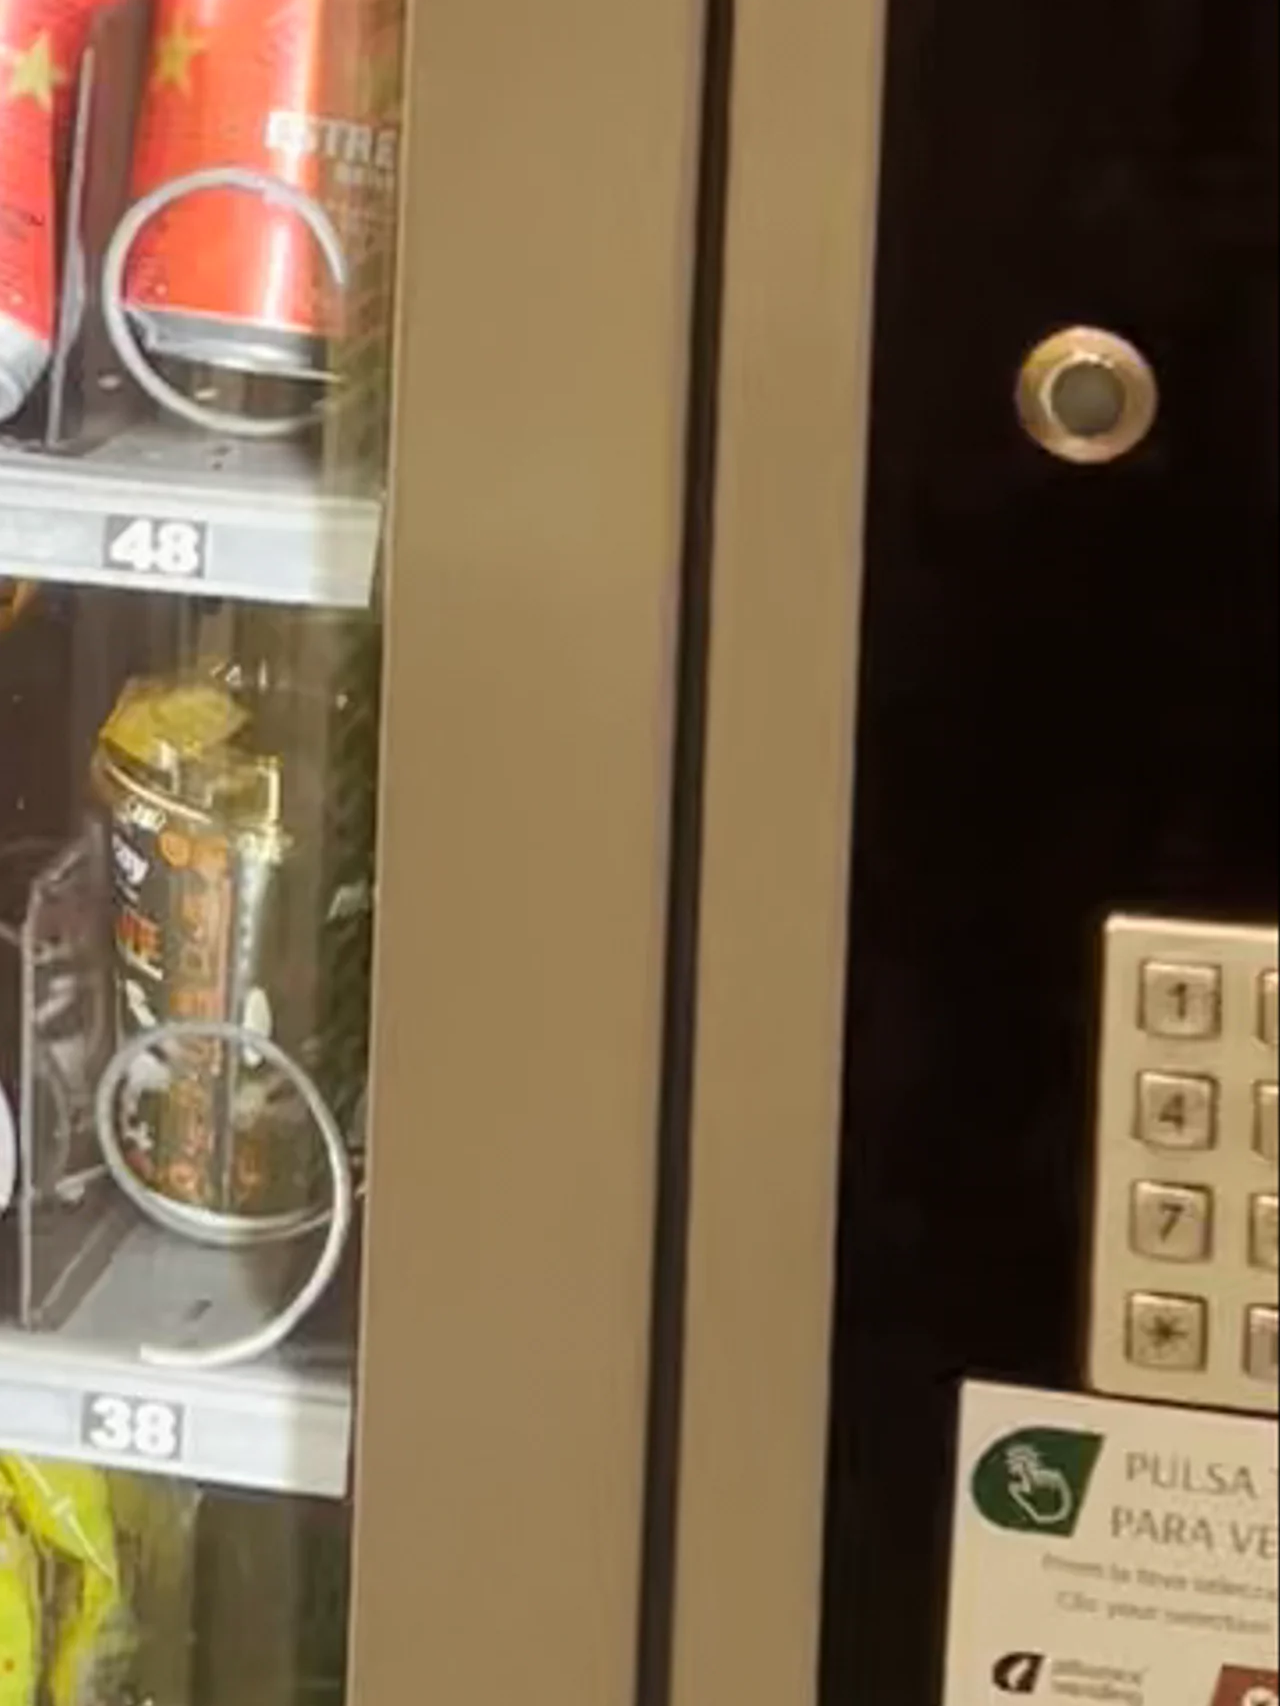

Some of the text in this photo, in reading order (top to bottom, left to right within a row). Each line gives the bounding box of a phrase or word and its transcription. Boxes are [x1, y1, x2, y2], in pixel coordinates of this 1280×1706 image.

[107, 518, 202, 573] 48
[1158, 1092, 1185, 1135] 4
[1158, 1202, 1186, 1243] 7
[89, 1399, 175, 1453] 38
[1125, 1450, 1258, 1500] PULSA
[1110, 1504, 1215, 1550] PARA
